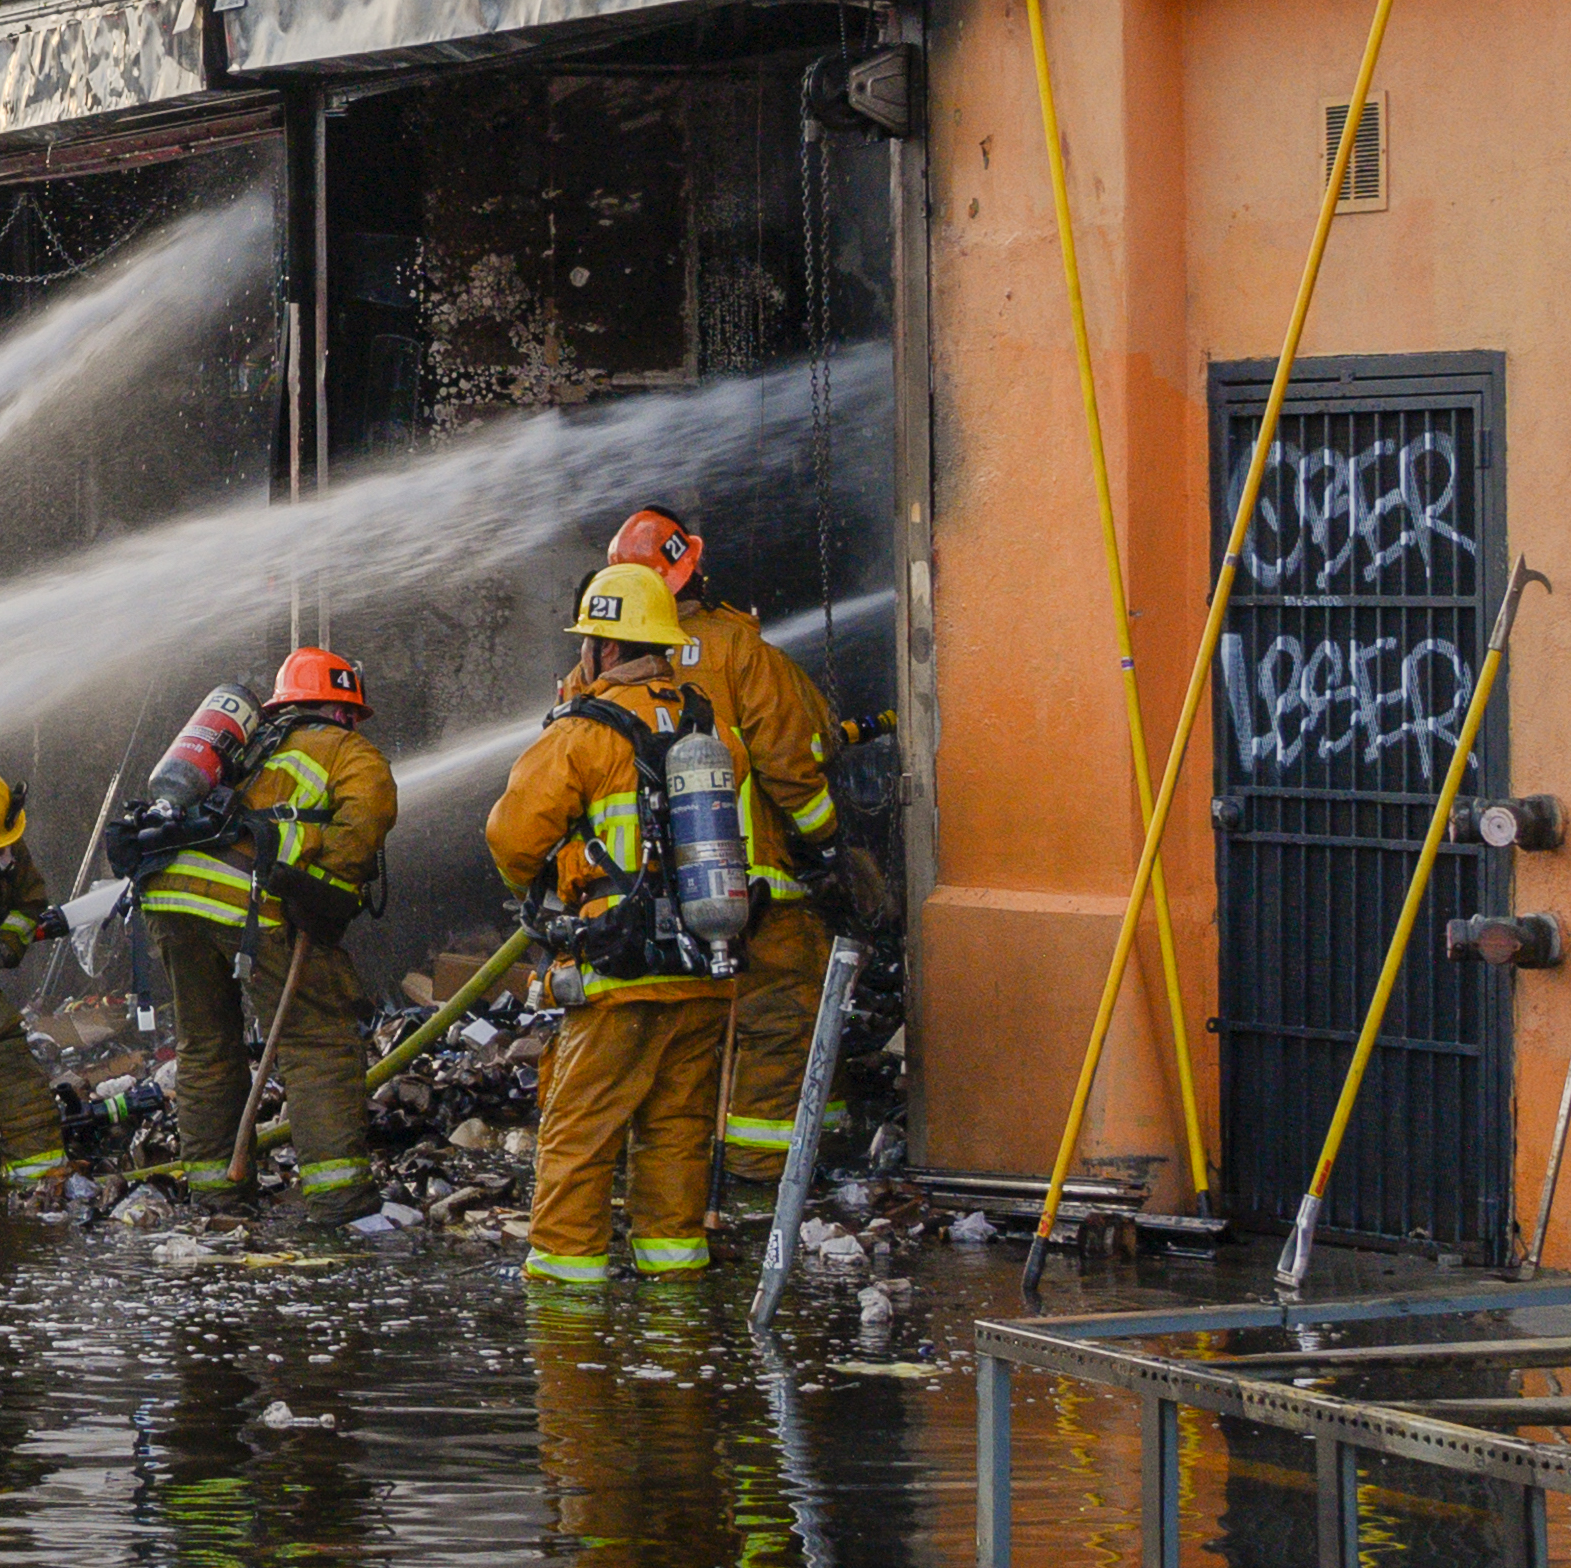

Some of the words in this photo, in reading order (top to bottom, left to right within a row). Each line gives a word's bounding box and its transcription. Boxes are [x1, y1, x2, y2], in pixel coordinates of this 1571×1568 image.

[665, 534, 687, 561] 21
[591, 597, 618, 619] 21
[337, 670, 351, 689] 4
